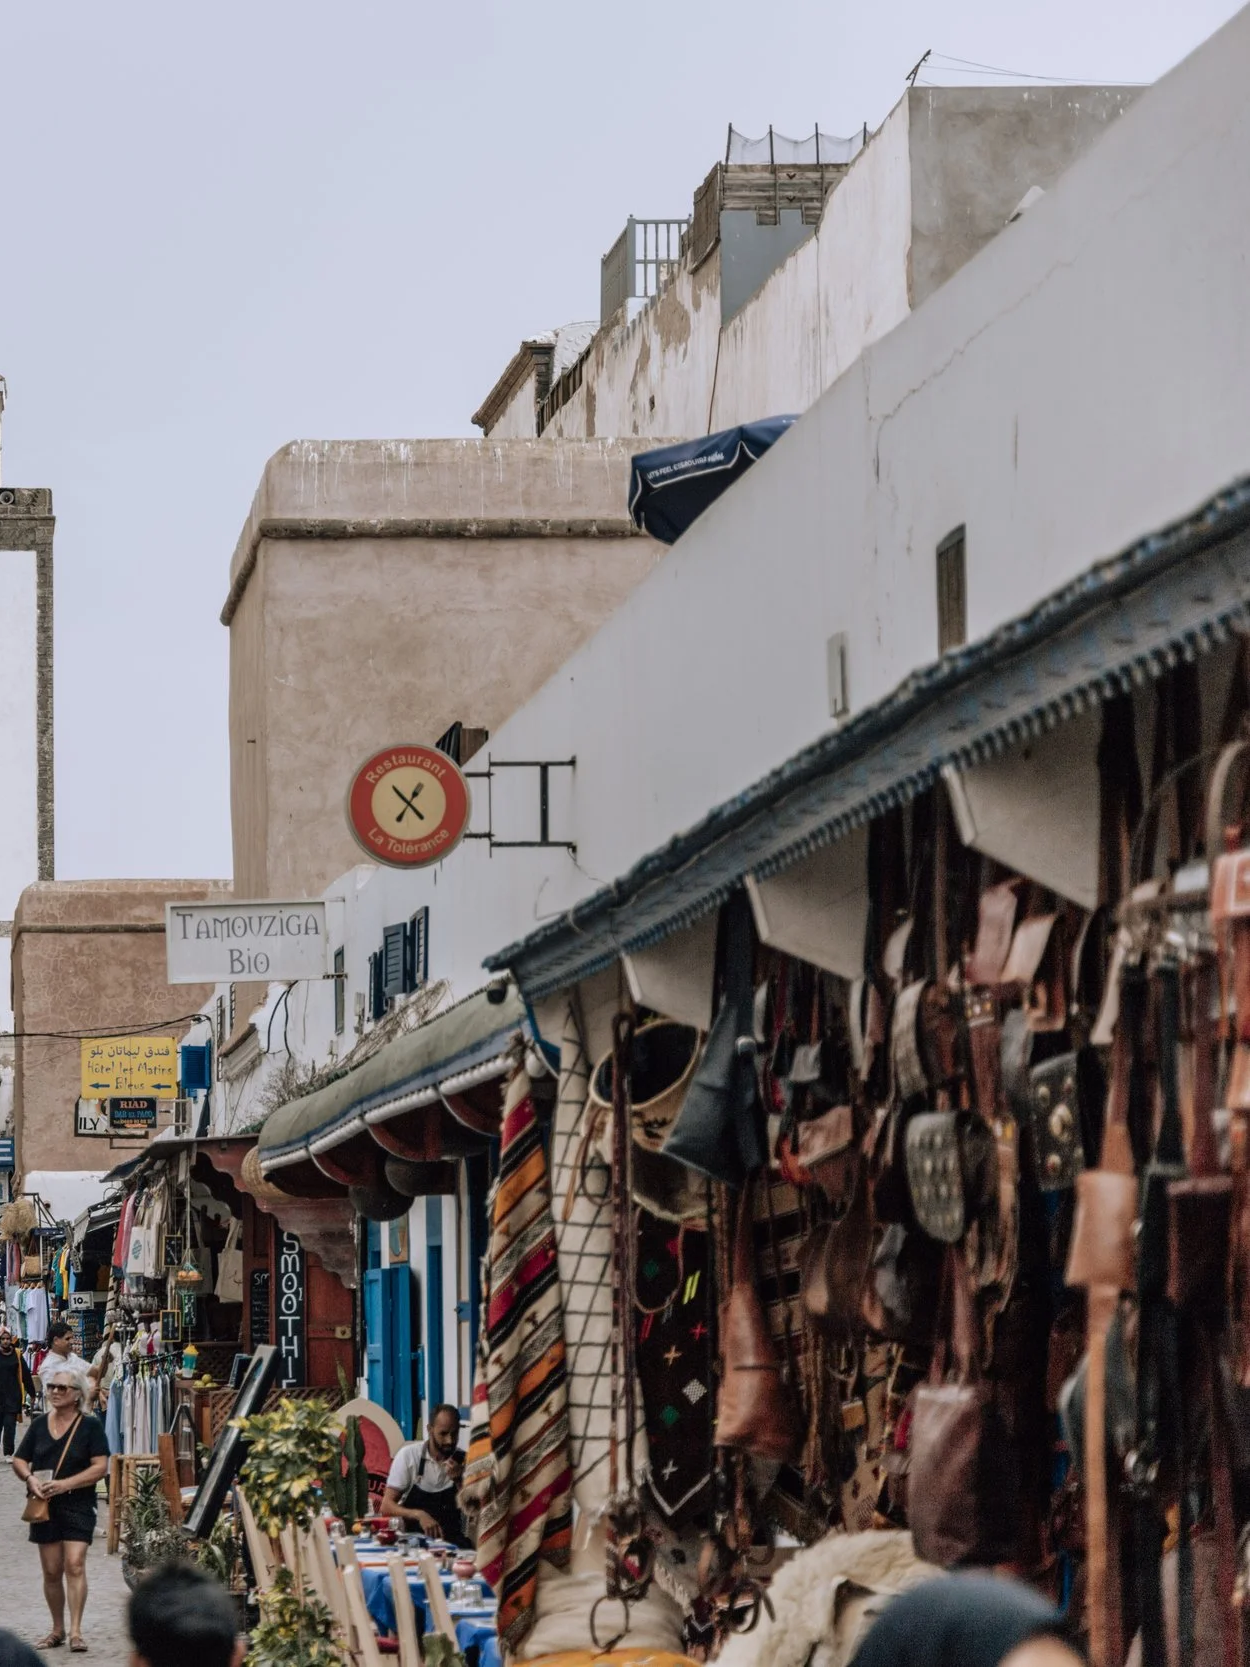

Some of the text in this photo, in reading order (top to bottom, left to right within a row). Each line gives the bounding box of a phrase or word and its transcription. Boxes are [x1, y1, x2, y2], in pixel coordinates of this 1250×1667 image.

[365, 754, 447, 784] Restaurant
[367, 827, 449, 854] La Tolérance
[90, 1045, 104, 1058] بلو
[144, 1047, 170, 1058] فندق
[87, 1061, 114, 1074] Hôtel
[119, 1061, 133, 1075] les
[73, 1297, 83, 1305] 10
